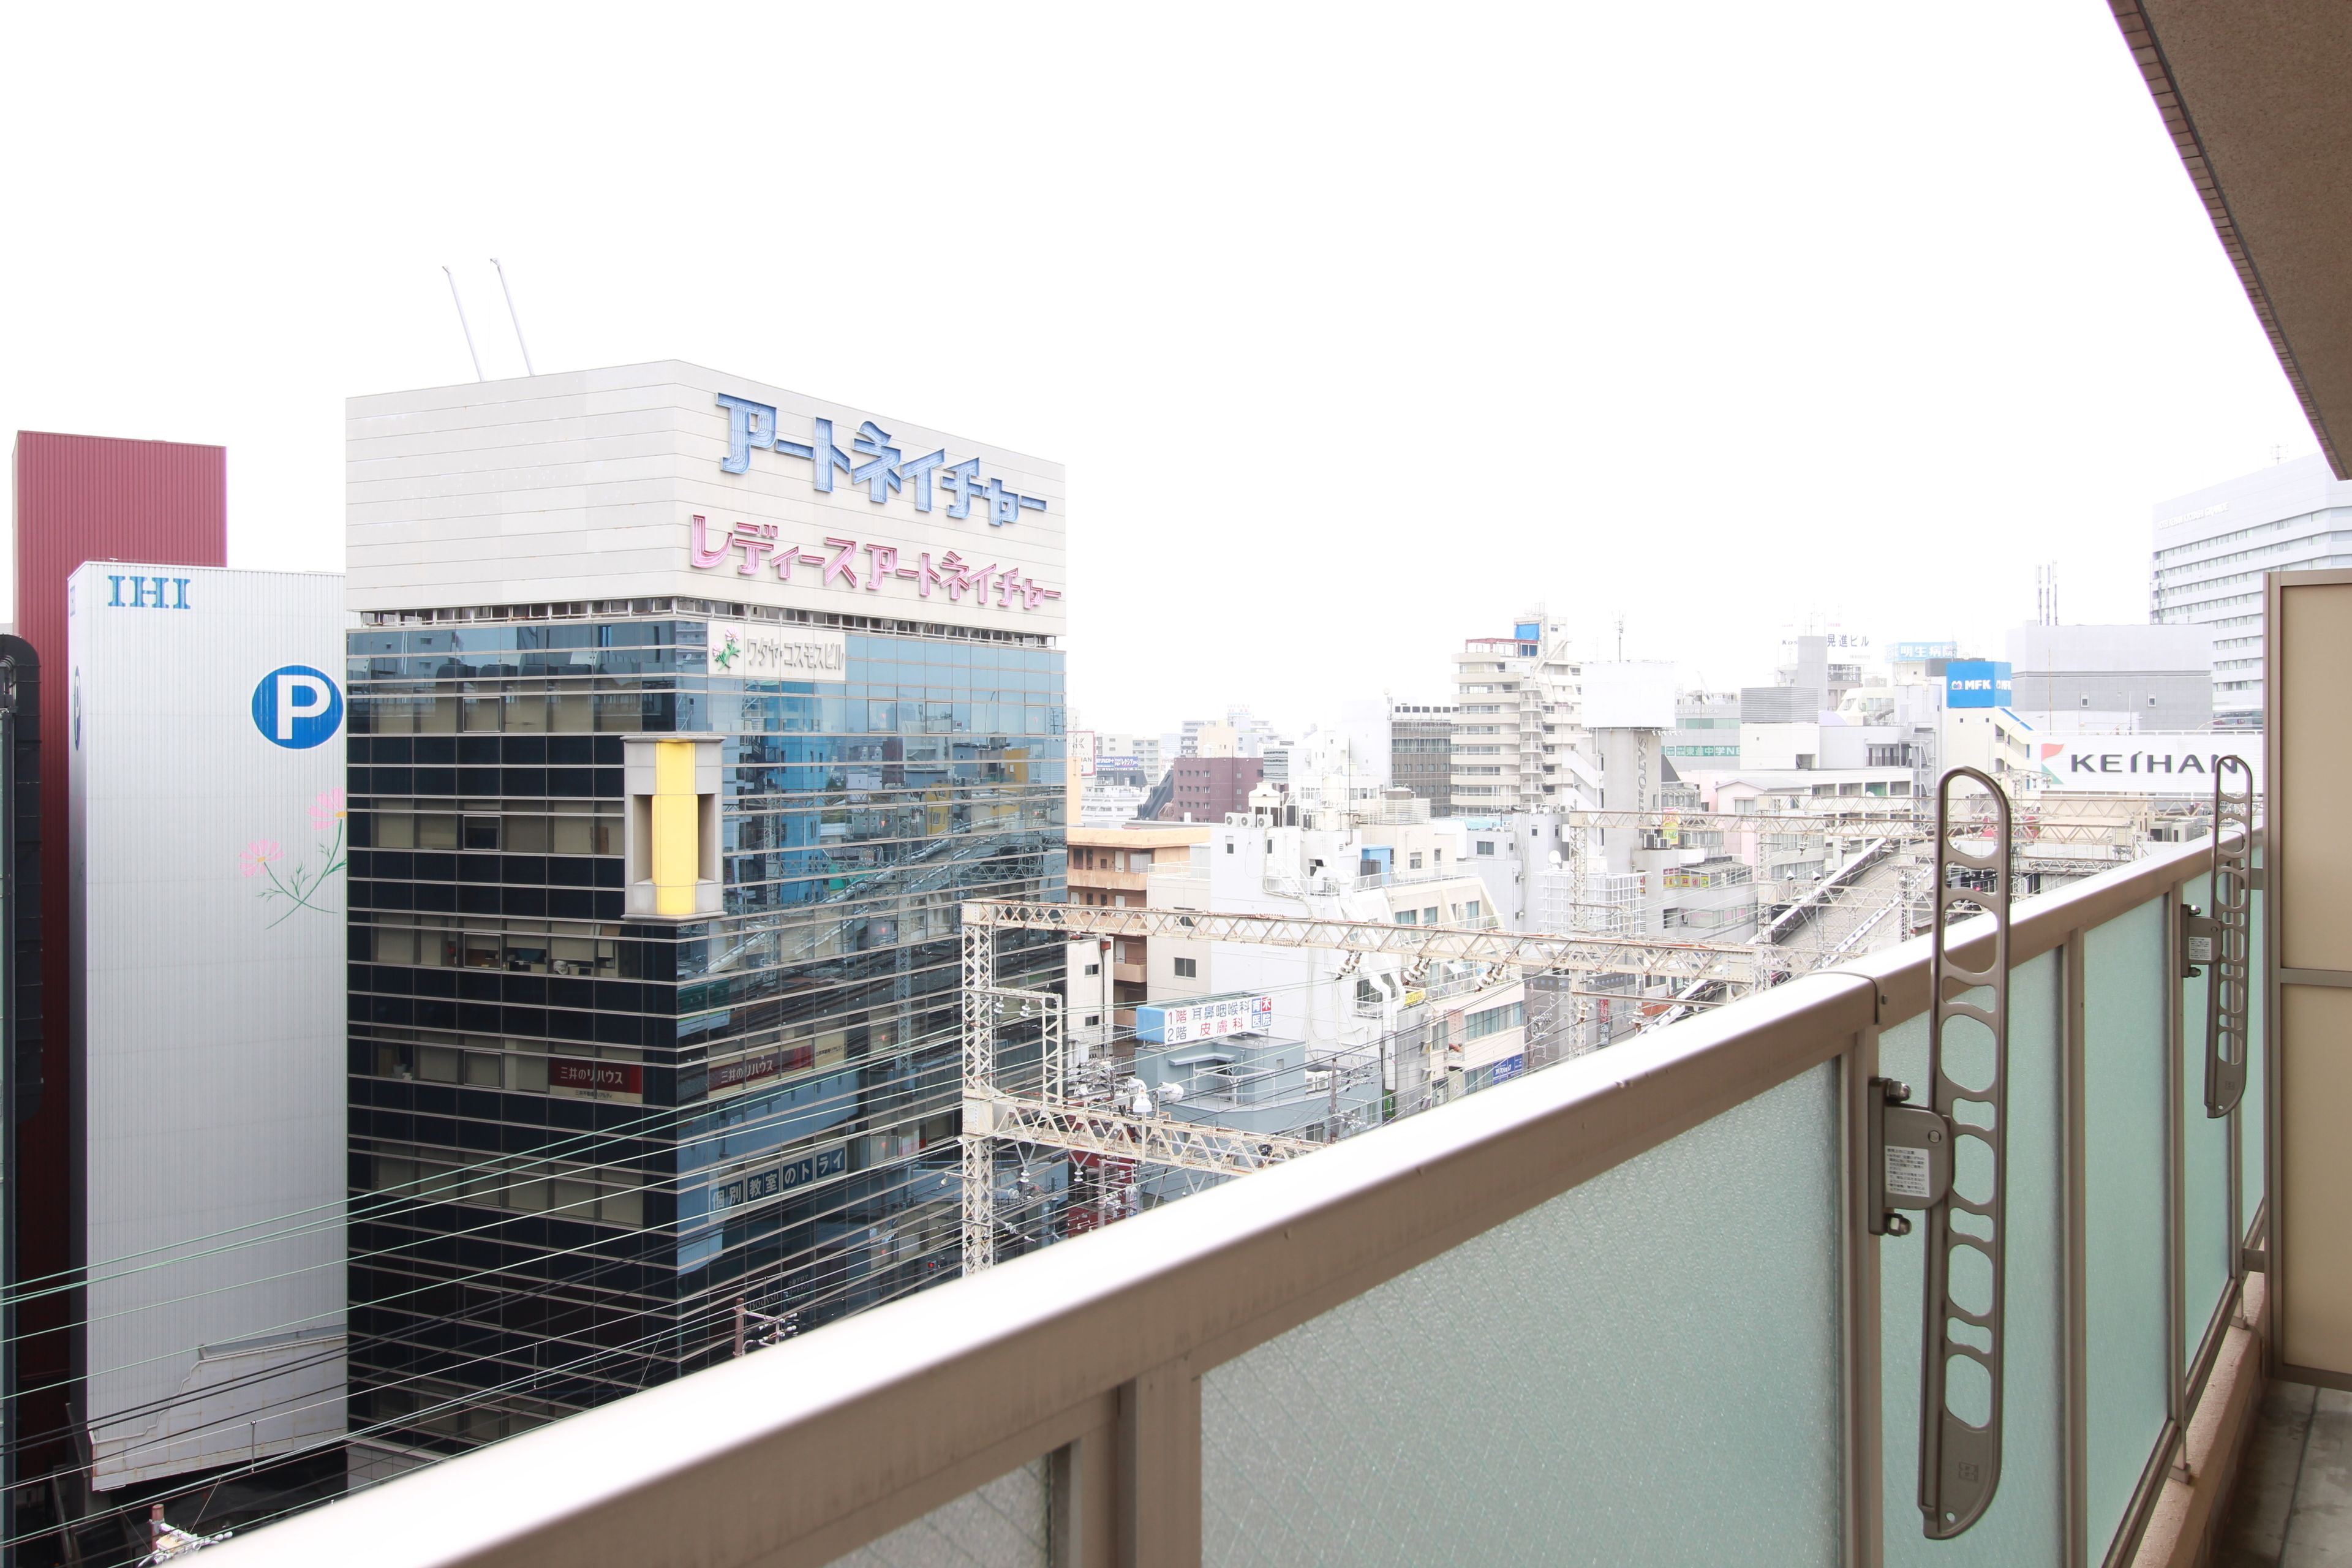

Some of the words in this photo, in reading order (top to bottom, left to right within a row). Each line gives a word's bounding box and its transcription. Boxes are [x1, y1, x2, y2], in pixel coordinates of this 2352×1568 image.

[715, 392, 1047, 526] アートネイチャー
[690, 514, 1061, 609] レディースアートネイチャー
[108, 575, 191, 609] IHI
[1964, 680, 1991, 690] MFK
[277, 674, 331, 740] P
[2070, 751, 2238, 774] KEIHAN
[1167, 1009, 1187, 1025] 1階
[1191, 1000, 1251, 1021] 耳鼻咽喉科
[1167, 1026, 1187, 1042] 2階
[1200, 1017, 1243, 1037] 皮膚科
[560, 1066, 623, 1085] 三井のリハウス
[721, 1060, 774, 1084] 三井のリハウス
[712, 1150, 843, 1210] 個別教室のトライ
